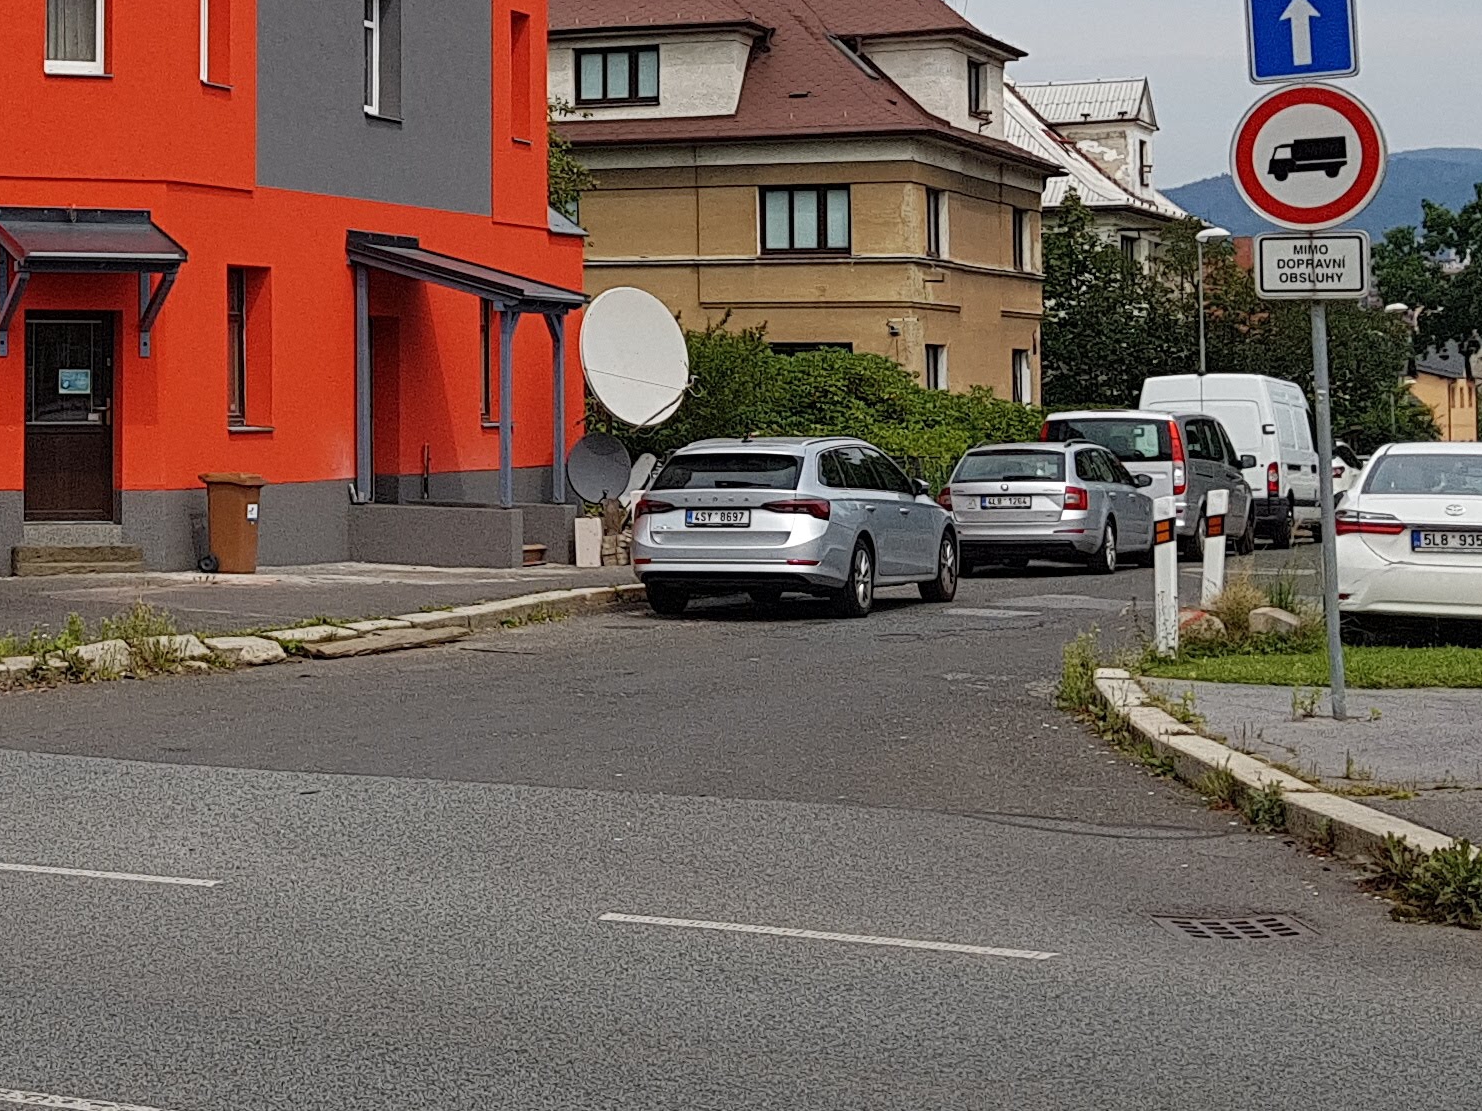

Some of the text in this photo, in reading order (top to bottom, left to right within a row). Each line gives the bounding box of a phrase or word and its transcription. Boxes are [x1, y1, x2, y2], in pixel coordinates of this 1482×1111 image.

[1293, 244, 1329, 255] MIMO
[1277, 255, 1346, 269] DOPRAVNÍ
[1279, 272, 1344, 284] OBSLUHY
[694, 512, 713, 522] 4SY
[1424, 533, 1449, 546] 5L8
